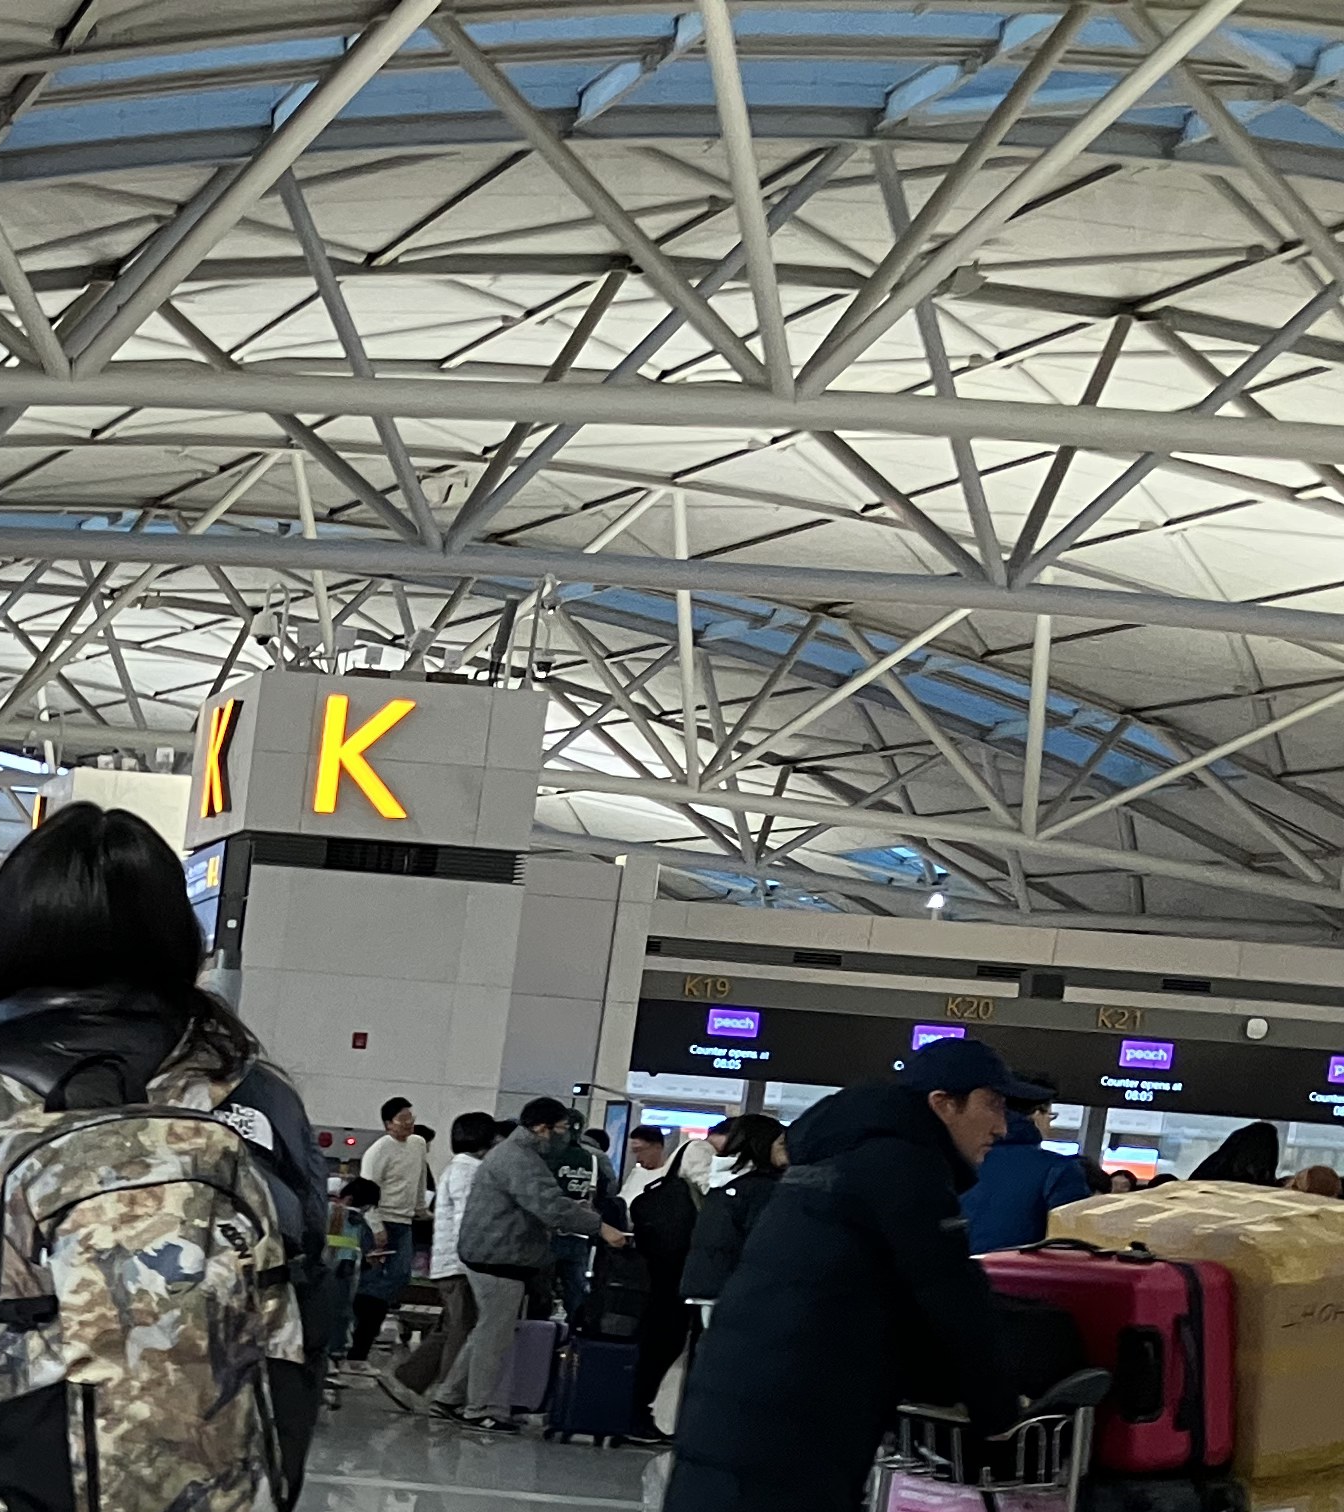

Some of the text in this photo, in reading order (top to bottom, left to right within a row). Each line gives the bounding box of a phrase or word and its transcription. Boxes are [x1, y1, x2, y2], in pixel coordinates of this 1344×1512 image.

[313, 694, 417, 819] K
[683, 975, 732, 999] K19
[946, 997, 993, 1020] K20
[713, 1016, 754, 1031] peach
[1096, 1007, 1143, 1030] K21
[689, 1045, 770, 1060] Counter opens at
[1125, 1048, 1168, 1062] peach
[713, 1057, 742, 1070] 08:05
[1100, 1075, 1183, 1091] Counter opens at
[1125, 1089, 1153, 1101] 08:05
